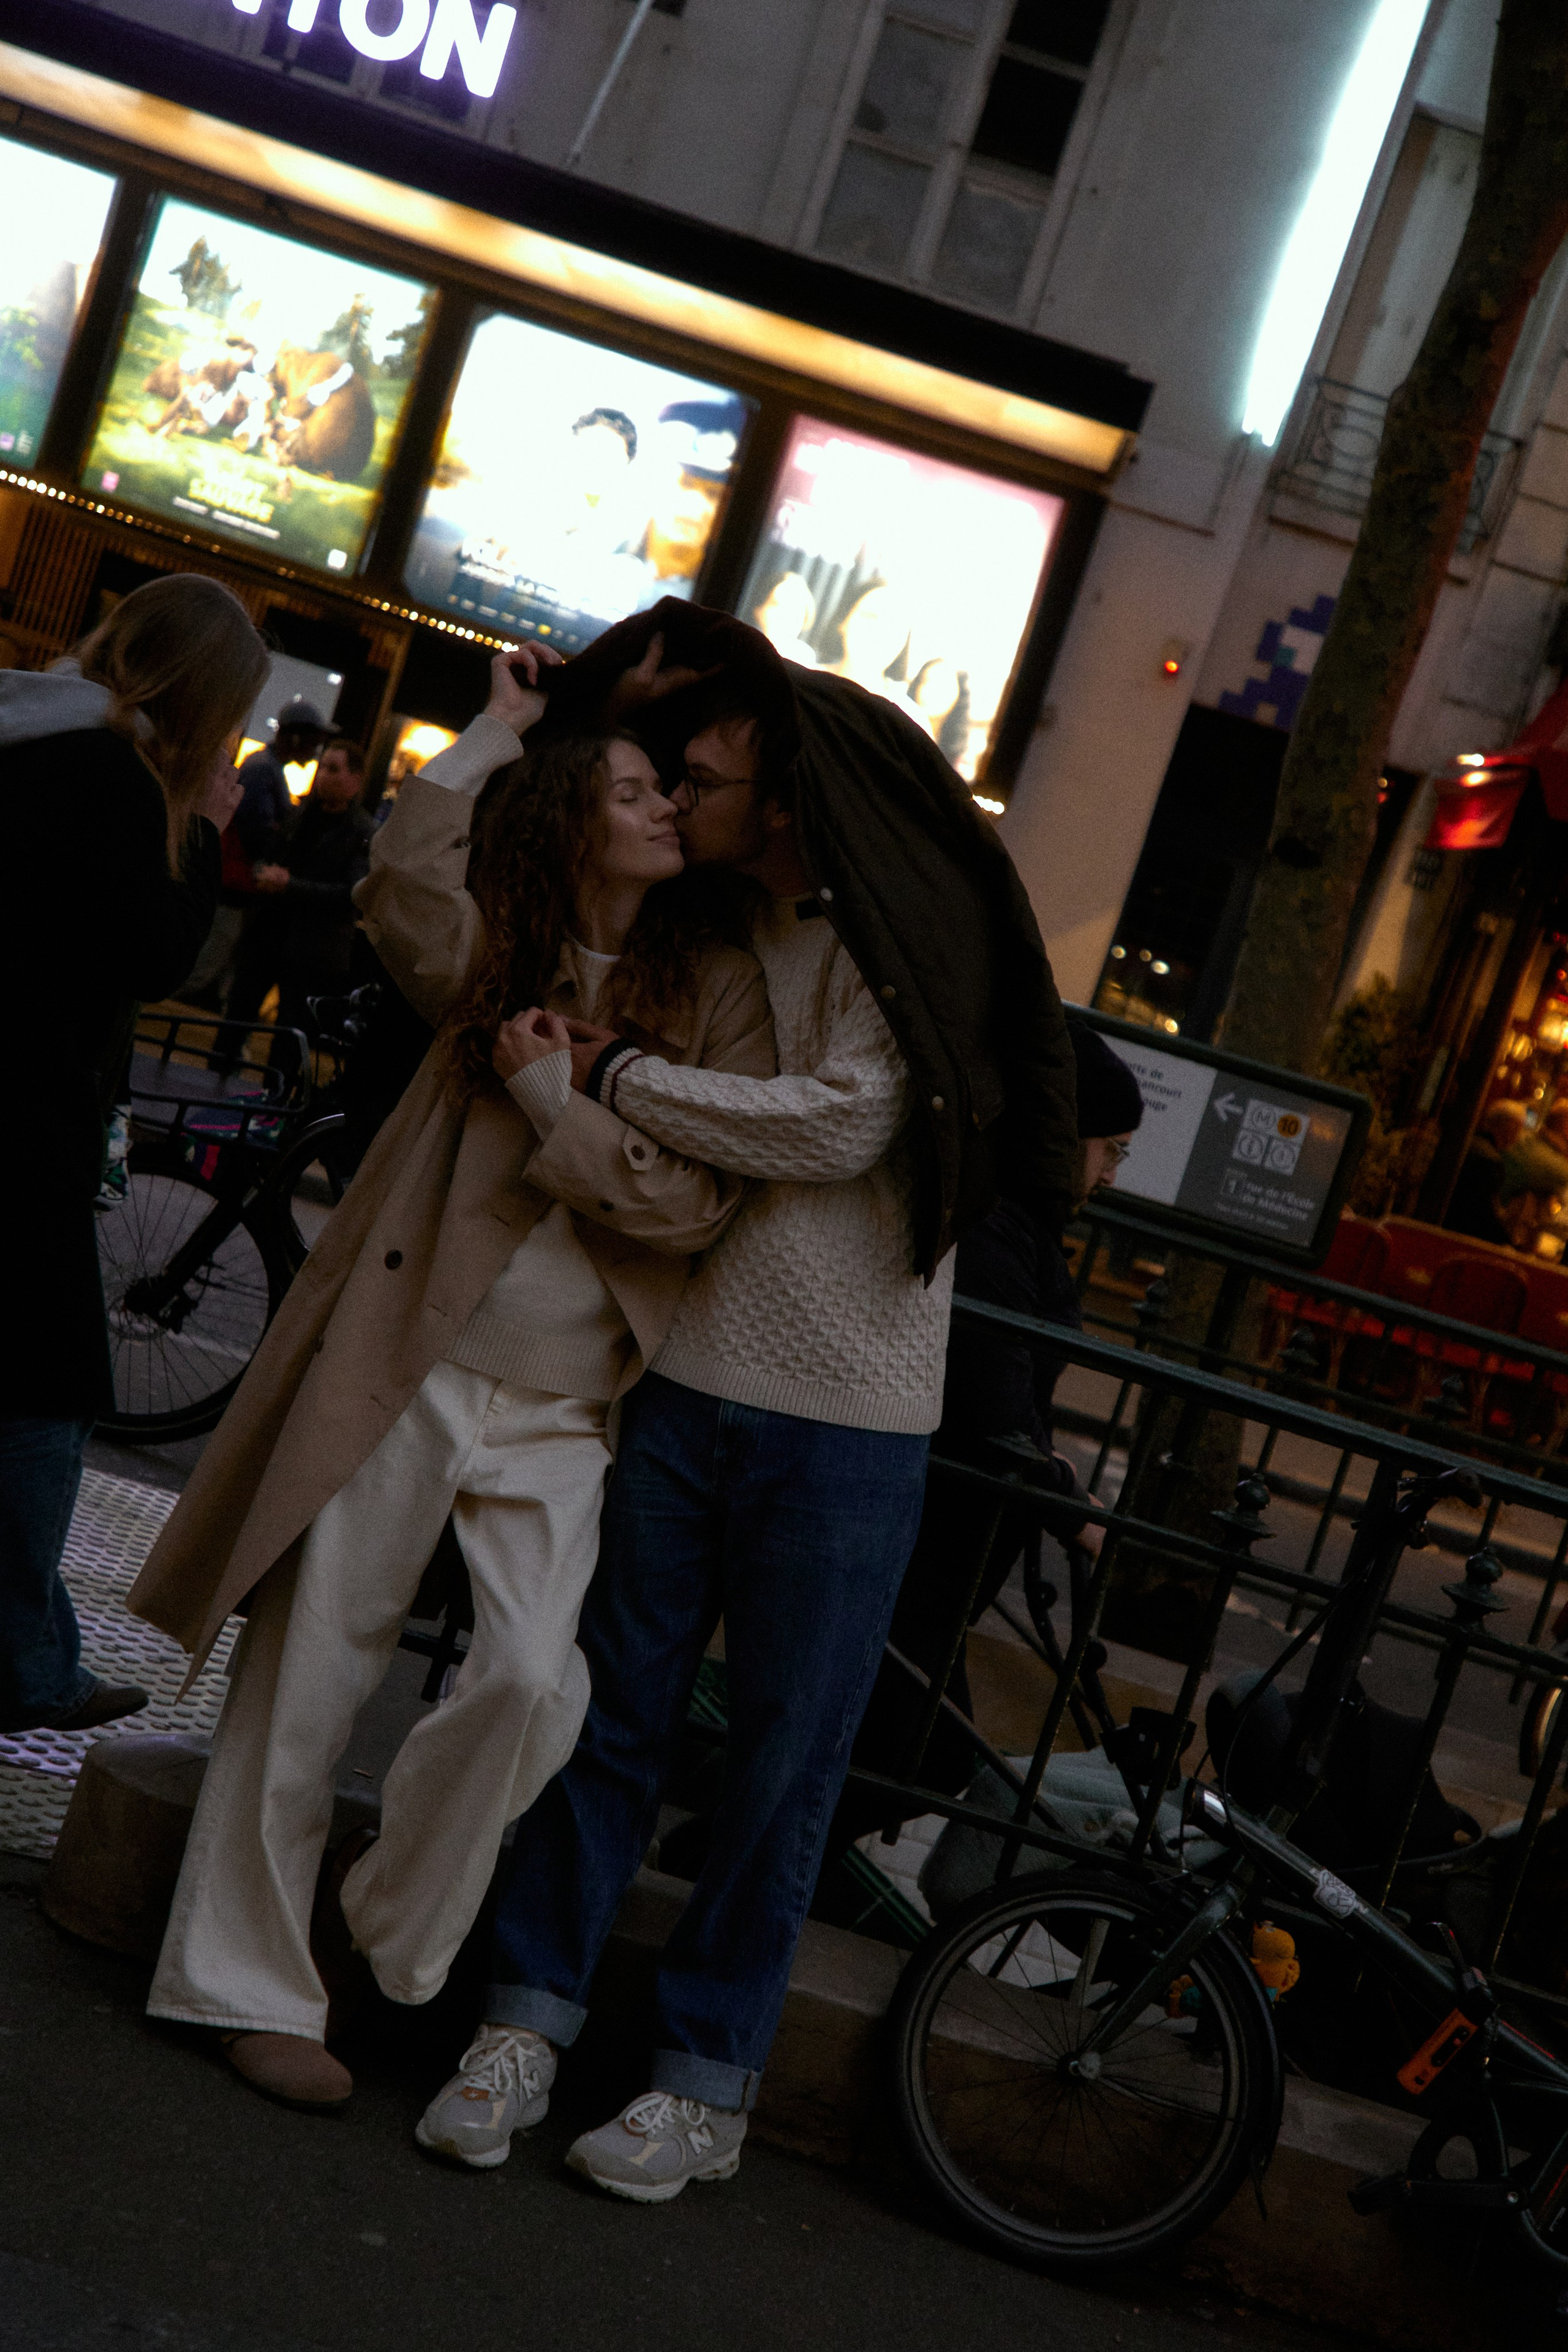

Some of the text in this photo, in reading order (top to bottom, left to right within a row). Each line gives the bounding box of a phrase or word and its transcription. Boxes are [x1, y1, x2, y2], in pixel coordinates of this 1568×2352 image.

[232, 0, 518, 98] ON
[1138, 1080, 1182, 1098] ancourt
[1144, 1098, 1167, 1112] ouge
[1280, 1118, 1299, 1136] 10
